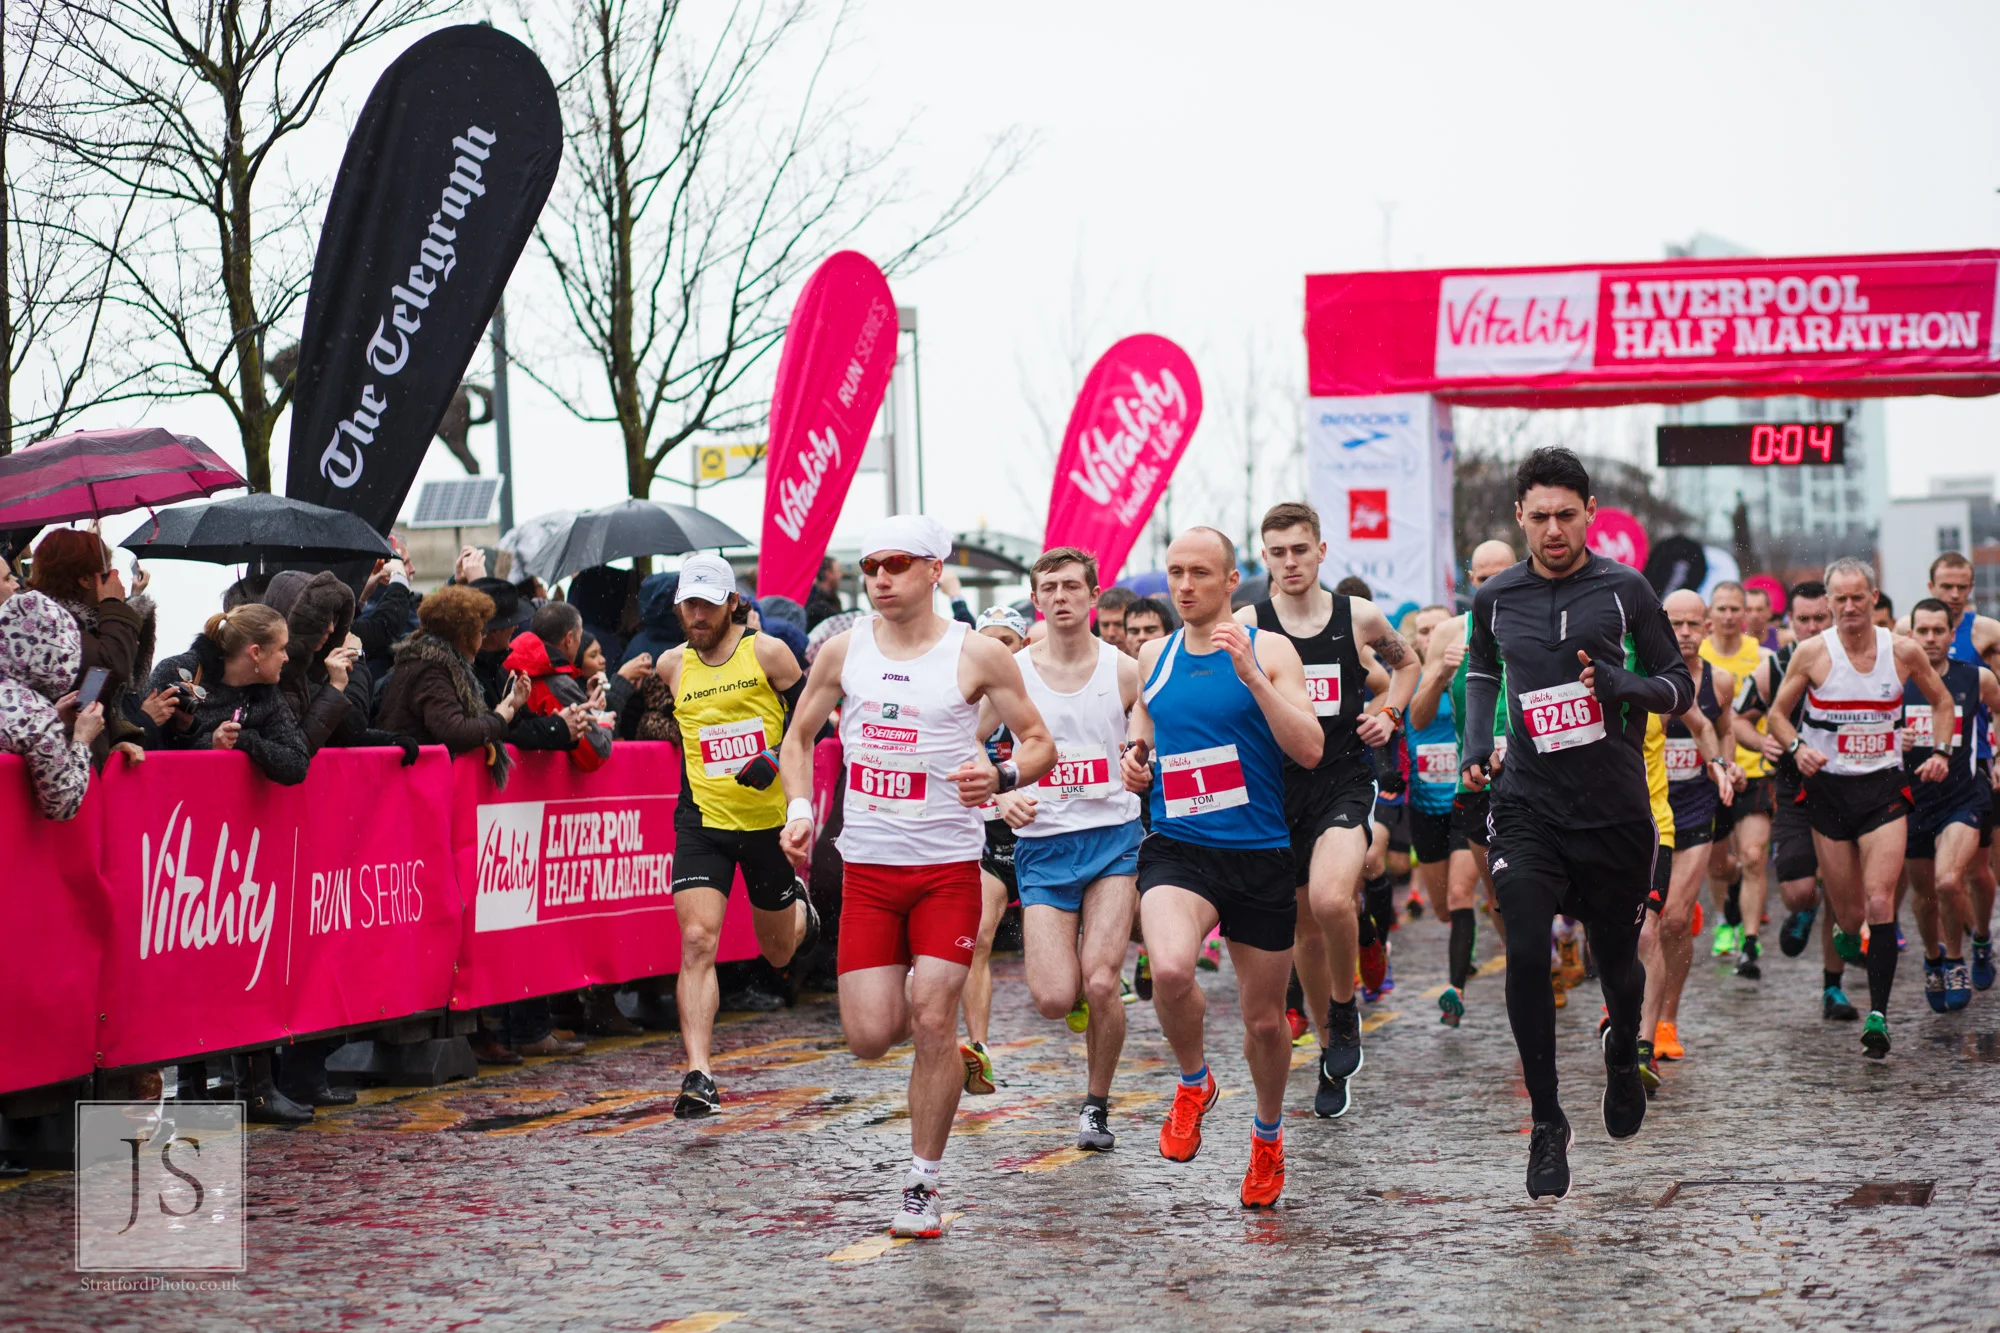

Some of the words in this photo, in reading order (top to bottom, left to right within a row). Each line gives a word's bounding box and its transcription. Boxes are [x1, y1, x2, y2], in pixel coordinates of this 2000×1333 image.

[320, 384, 387, 488] The
[366, 125, 497, 375] Telegraph
[1609, 274, 1869, 318] LIVERPOOL
[1447, 286, 1589, 364] Vitality
[1612, 318, 1726, 359] HALF
[1733, 310, 1980, 355] MARATHON
[774, 425, 841, 542] Vitality
[837, 357, 865, 408] RUN
[855, 296, 888, 364] SERIES
[1068, 367, 1187, 505] Vitality
[1750, 424, 1834, 465] 0:04
[694, 687, 718, 699] team
[1529, 692, 1553, 705] Vitality
[1532, 699, 1592, 735] 6246
[708, 728, 728, 737] Vitality
[708, 733, 759, 761] 5000
[877, 729, 917, 741] ENERVIT
[1844, 734, 1888, 753] 4596
[861, 752, 883, 768] Vitality
[1050, 761, 1095, 785] 3371
[1169, 757, 1191, 768] Vitality
[1663, 750, 1697, 768] 829
[861, 768, 912, 798] 6119
[1061, 785, 1085, 794] LUKE
[1191, 768, 1207, 794] 1
[1191, 794, 1215, 806] TOM
[545, 809, 643, 858] LIVERPOOL
[476, 817, 538, 914] Vitality
[544, 858, 593, 908] HALF
[591, 853, 673, 900] MARATHO
[139, 799, 277, 992] Vitality
[309, 867, 352, 936] RUN
[359, 859, 425, 928] SERIES
